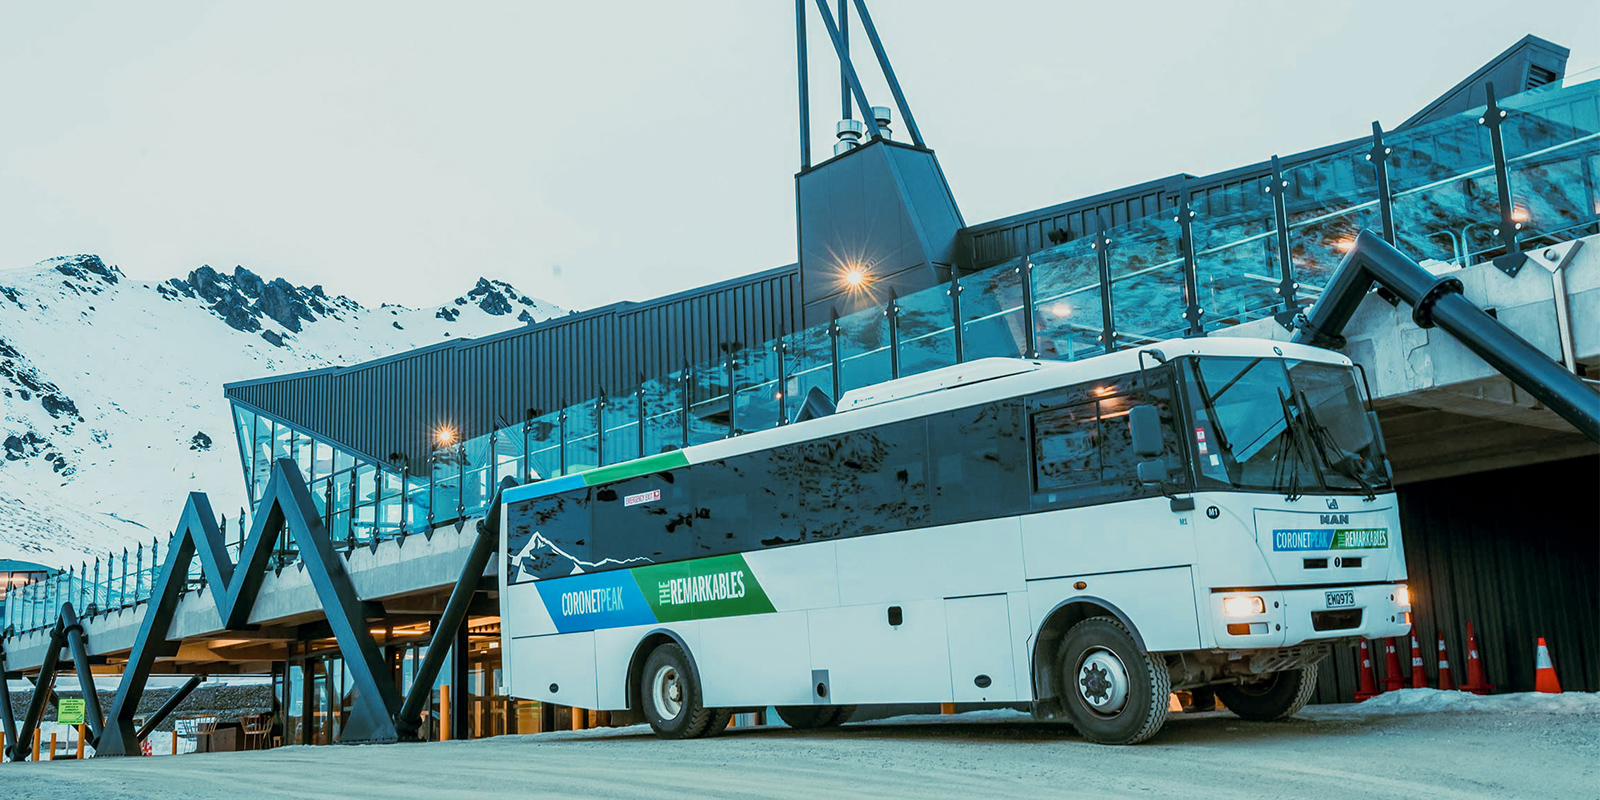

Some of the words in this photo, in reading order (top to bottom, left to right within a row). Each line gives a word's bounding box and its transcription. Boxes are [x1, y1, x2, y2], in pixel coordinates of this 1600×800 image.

[1208, 508, 1218, 516] M1
[1320, 515, 1349, 525] MAN
[1337, 532, 1345, 547] THE
[1344, 530, 1387, 547] REMARKABLES
[659, 581, 670, 605] THE
[670, 571, 745, 605] REMARKABLES
[1326, 592, 1354, 605] EMQ973
